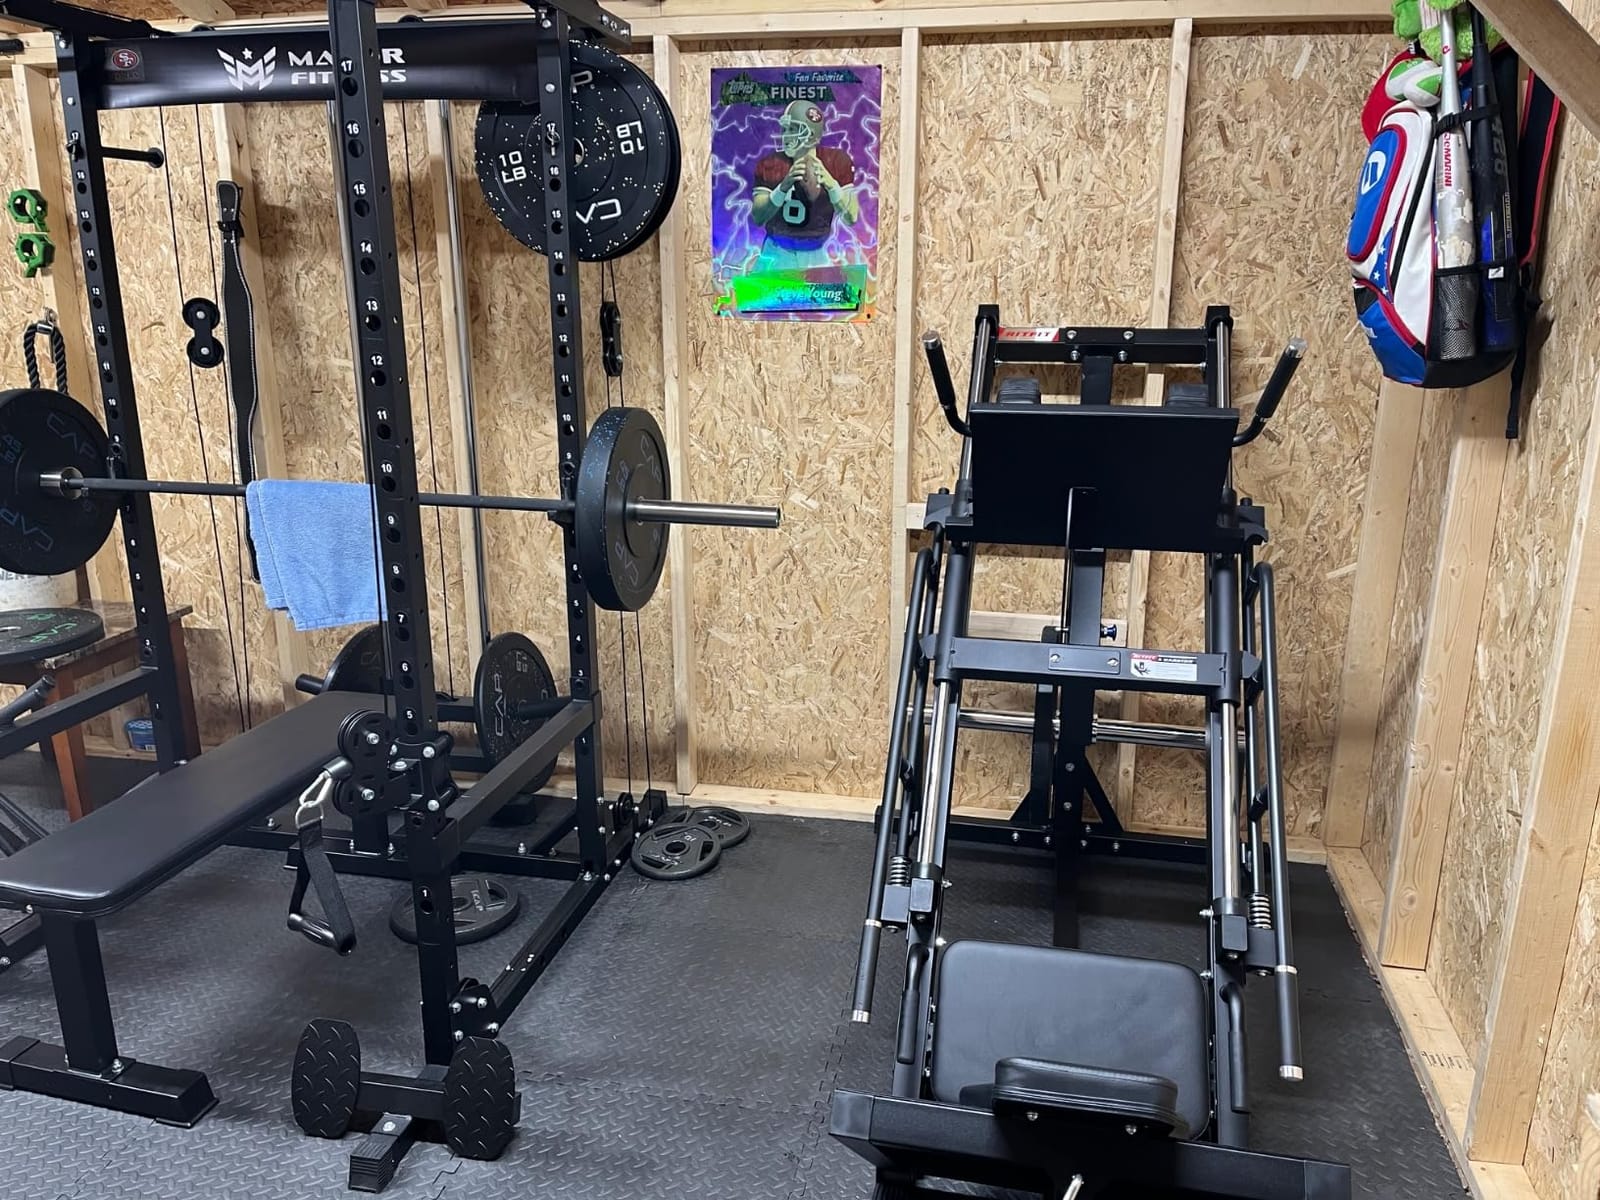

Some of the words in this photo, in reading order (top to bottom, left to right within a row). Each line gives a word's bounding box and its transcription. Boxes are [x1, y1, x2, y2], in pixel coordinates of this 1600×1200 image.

[341, 60, 353, 72] 17
[794, 72, 809, 82] Fan
[812, 71, 844, 82] Favorite
[770, 86, 827, 99] FINEST
[347, 122, 359, 135] 16
[616, 120, 643, 139] LB
[620, 137, 645, 155] 10
[499, 150, 523, 167] 10
[501, 166, 527, 183] LB
[549, 166, 559, 176] 16
[353, 183, 366, 195] 15
[551, 209, 562, 219] 15
[575, 198, 622, 224] CA
[360, 242, 373, 254] 14
[554, 251, 563, 260] 14
[556, 293, 566, 302] 13
[808, 285, 842, 301] Young
[365, 300, 378, 312] 13
[558, 334, 568, 343] 12
[371, 355, 384, 366] 12
[560, 374, 570, 383] 11
[376, 409, 387, 420] 11
[562, 414, 572, 422] 10
[381, 463, 393, 473] 10
[387, 515, 395, 525] 9
[392, 564, 400, 575] 8
[397, 614, 405, 624] 7
[401, 662, 409, 672] 6
[494, 672, 504, 737] CAP
[406, 710, 414, 720] 5
[422, 889, 428, 898] 1
